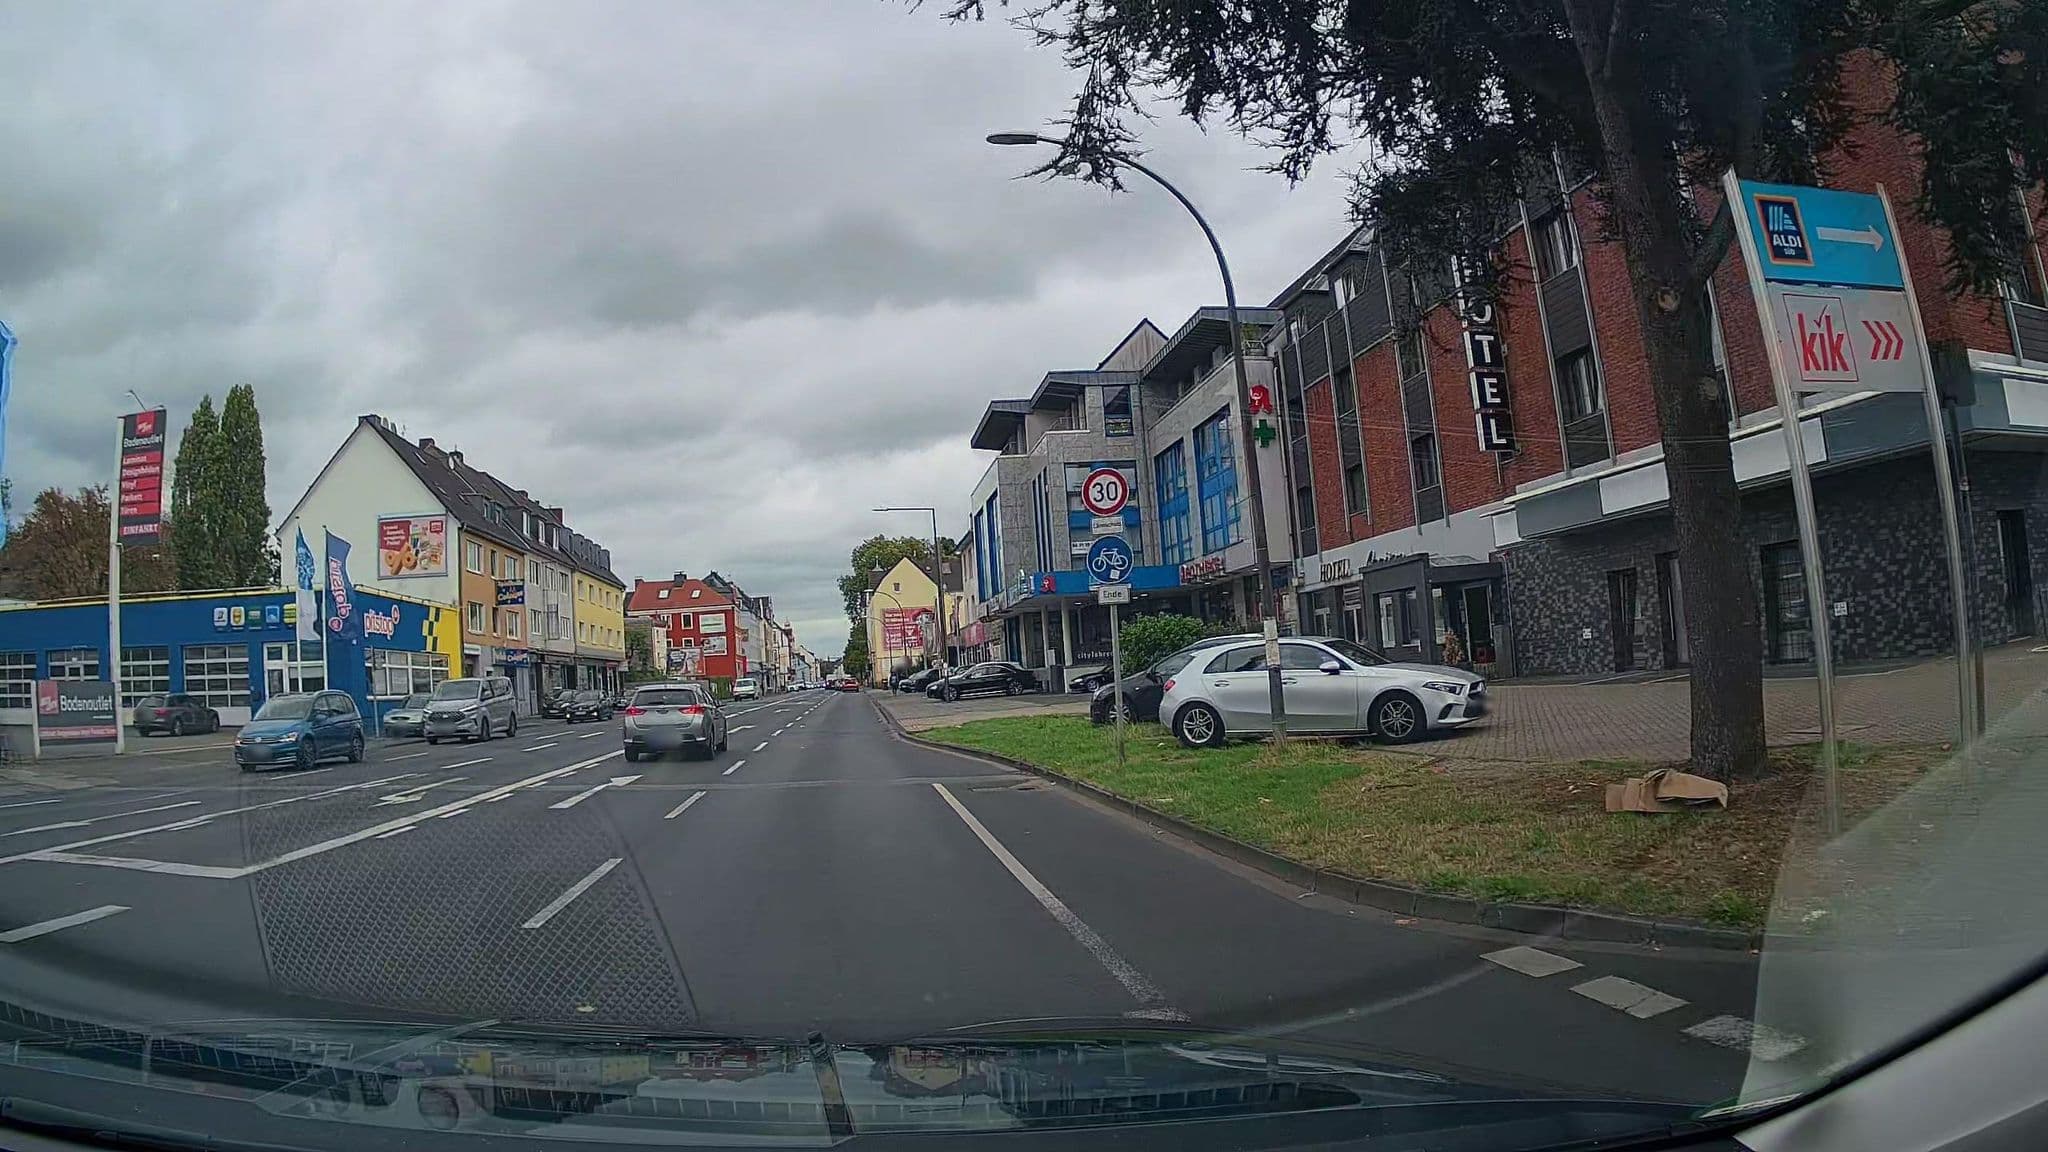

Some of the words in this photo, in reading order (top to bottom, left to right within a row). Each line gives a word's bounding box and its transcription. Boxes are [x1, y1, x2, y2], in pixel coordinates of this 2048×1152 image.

[1773, 233, 1802, 248] ALDI
[123, 434, 163, 448] Bodenoutlet
[1092, 481, 1118, 503] 30
[123, 523, 159, 536] EINFAHRT
[1320, 559, 1353, 582] HOTEL
[1103, 590, 1122, 599] Ende
[363, 608, 394, 640] pitstop
[60, 695, 113, 711] Bodenoutlet
